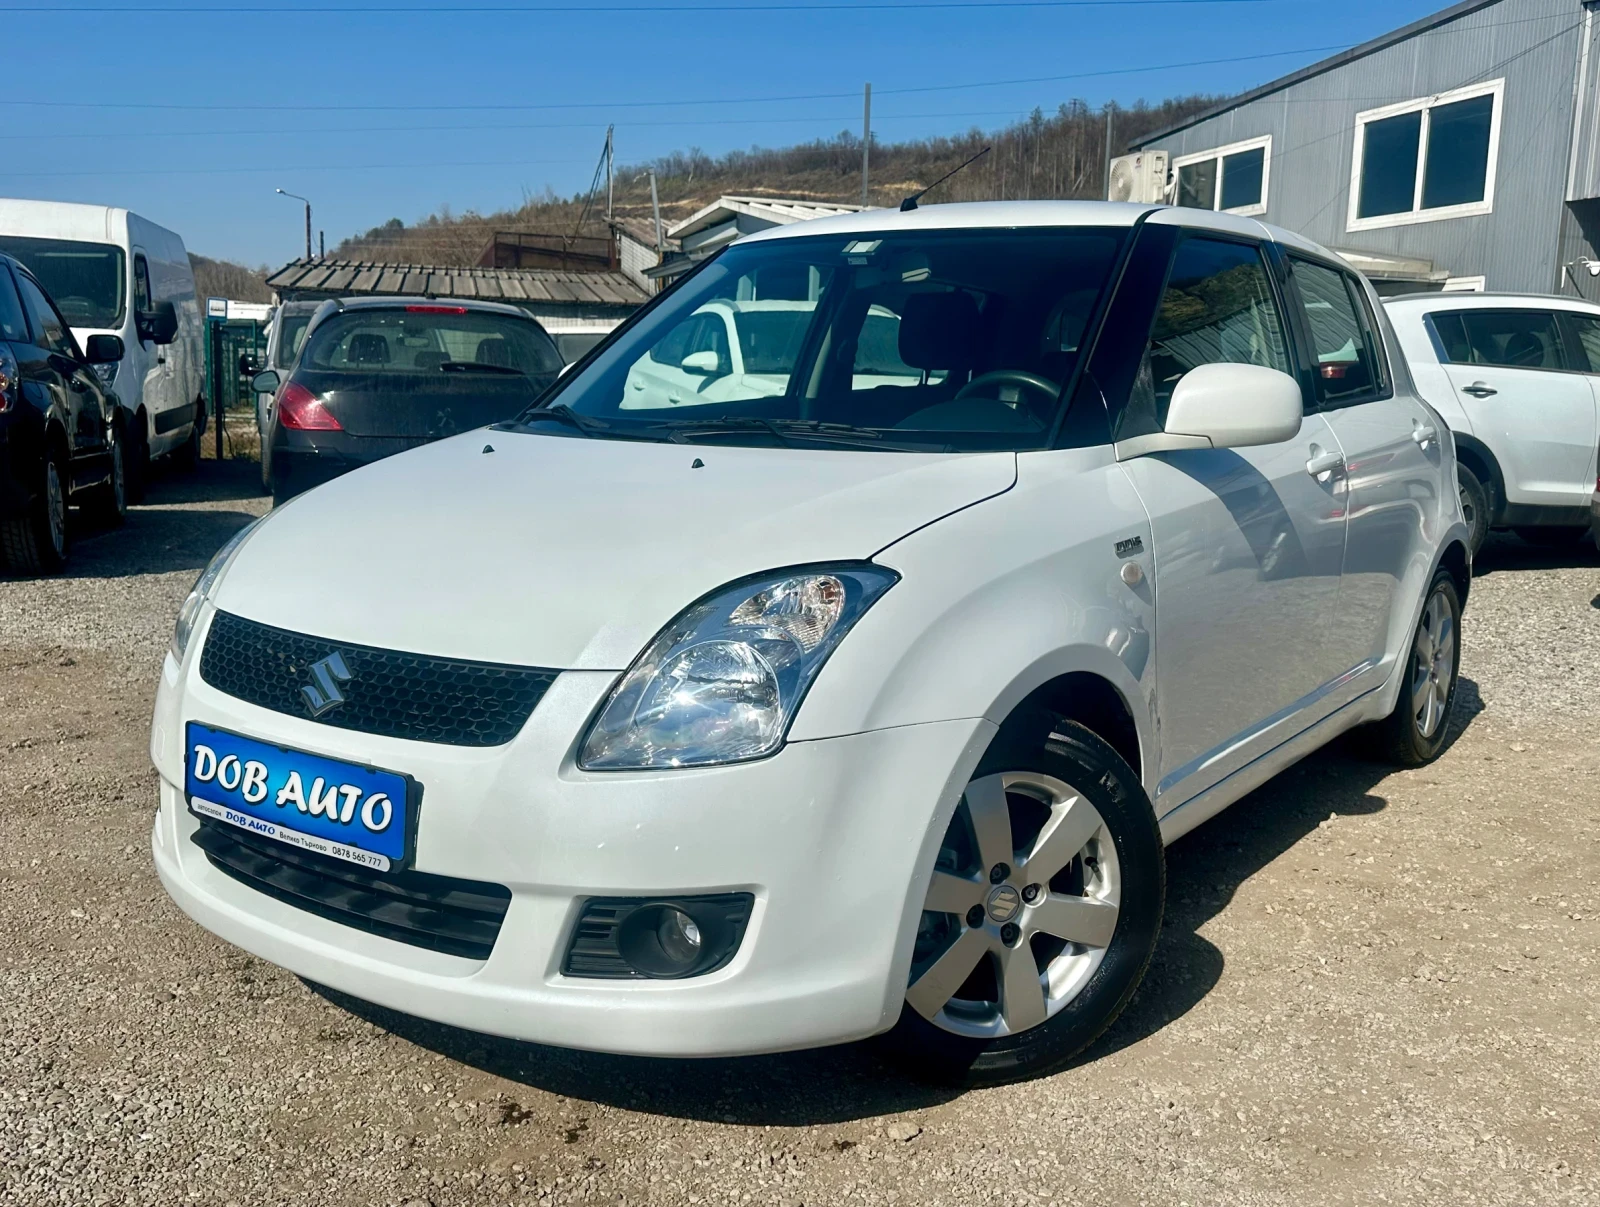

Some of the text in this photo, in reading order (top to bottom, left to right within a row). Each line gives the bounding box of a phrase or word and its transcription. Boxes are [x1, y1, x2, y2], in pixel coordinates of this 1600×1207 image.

[194, 744, 393, 831] DOB AUTO
[225, 811, 247, 826] DOB
[248, 820, 276, 835] AUTO
[279, 831, 300, 844] Велико
[300, 838, 327, 852] Търново
[332, 846, 351, 859] 0878
[352, 852, 366, 863] 565
[368, 856, 382, 867] 777
